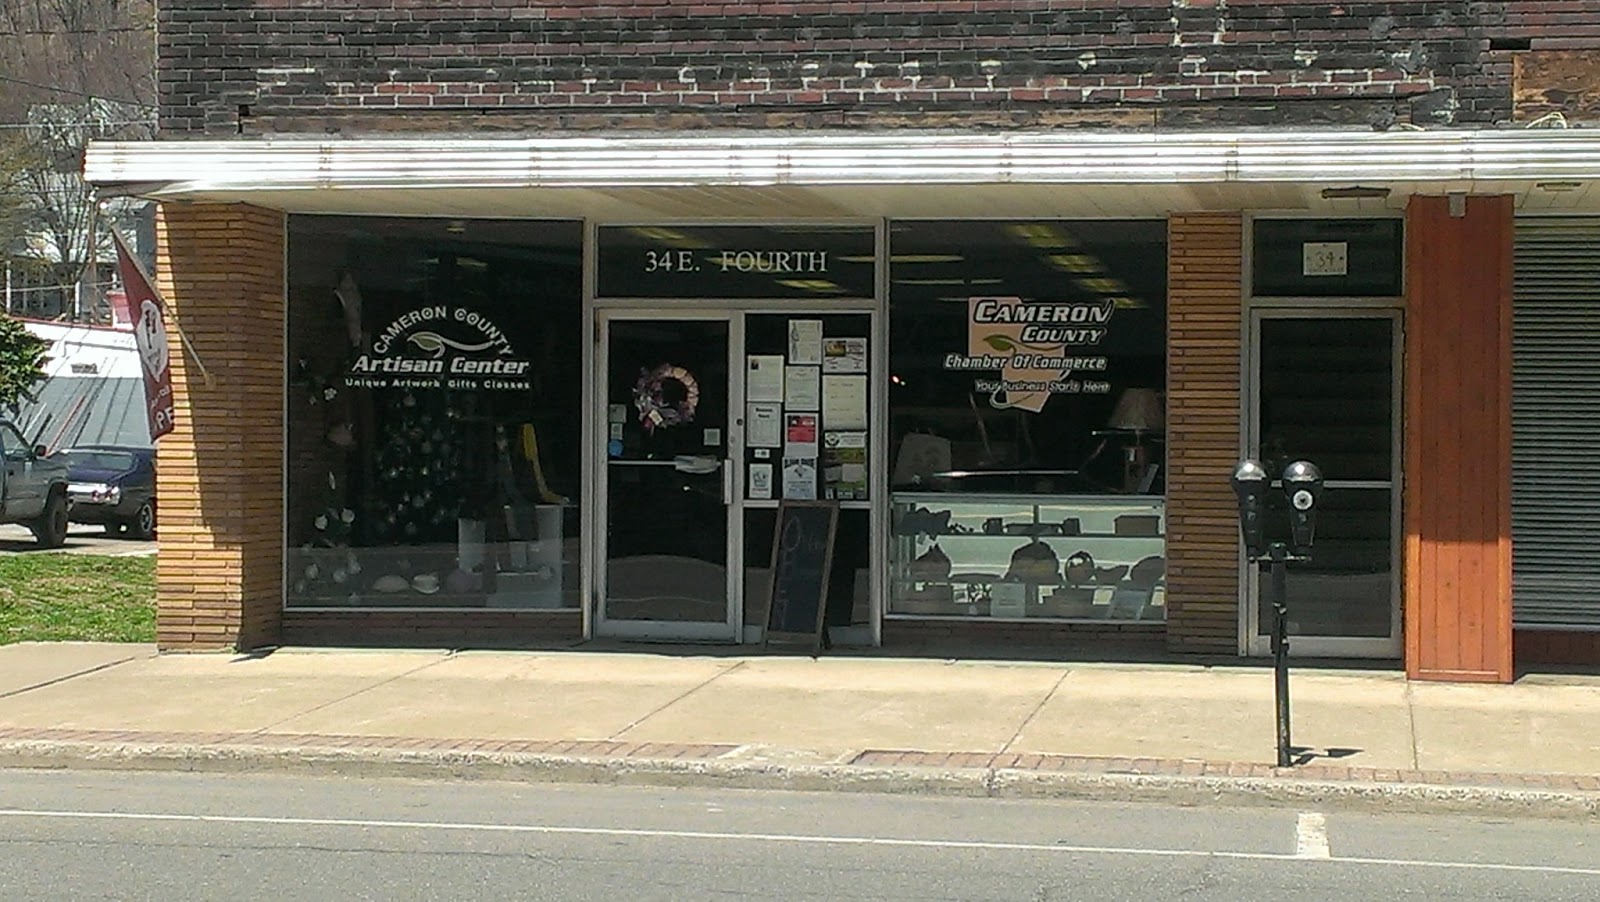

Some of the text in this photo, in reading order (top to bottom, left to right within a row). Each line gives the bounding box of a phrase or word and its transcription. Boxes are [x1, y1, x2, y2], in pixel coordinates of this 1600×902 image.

[720, 251, 828, 272] FOURTH
[975, 300, 1112, 323] CAMERON
[373, 305, 513, 355] CAMERON COUNTY
[1022, 326, 1104, 342] COUNTY
[351, 355, 530, 375] Artisan Center
[945, 354, 1106, 369] Chamber Of Commerce
[345, 378, 530, 389] Unique Artwork Gifts Classes
[976, 379, 1110, 393] Your Business Starts Here
